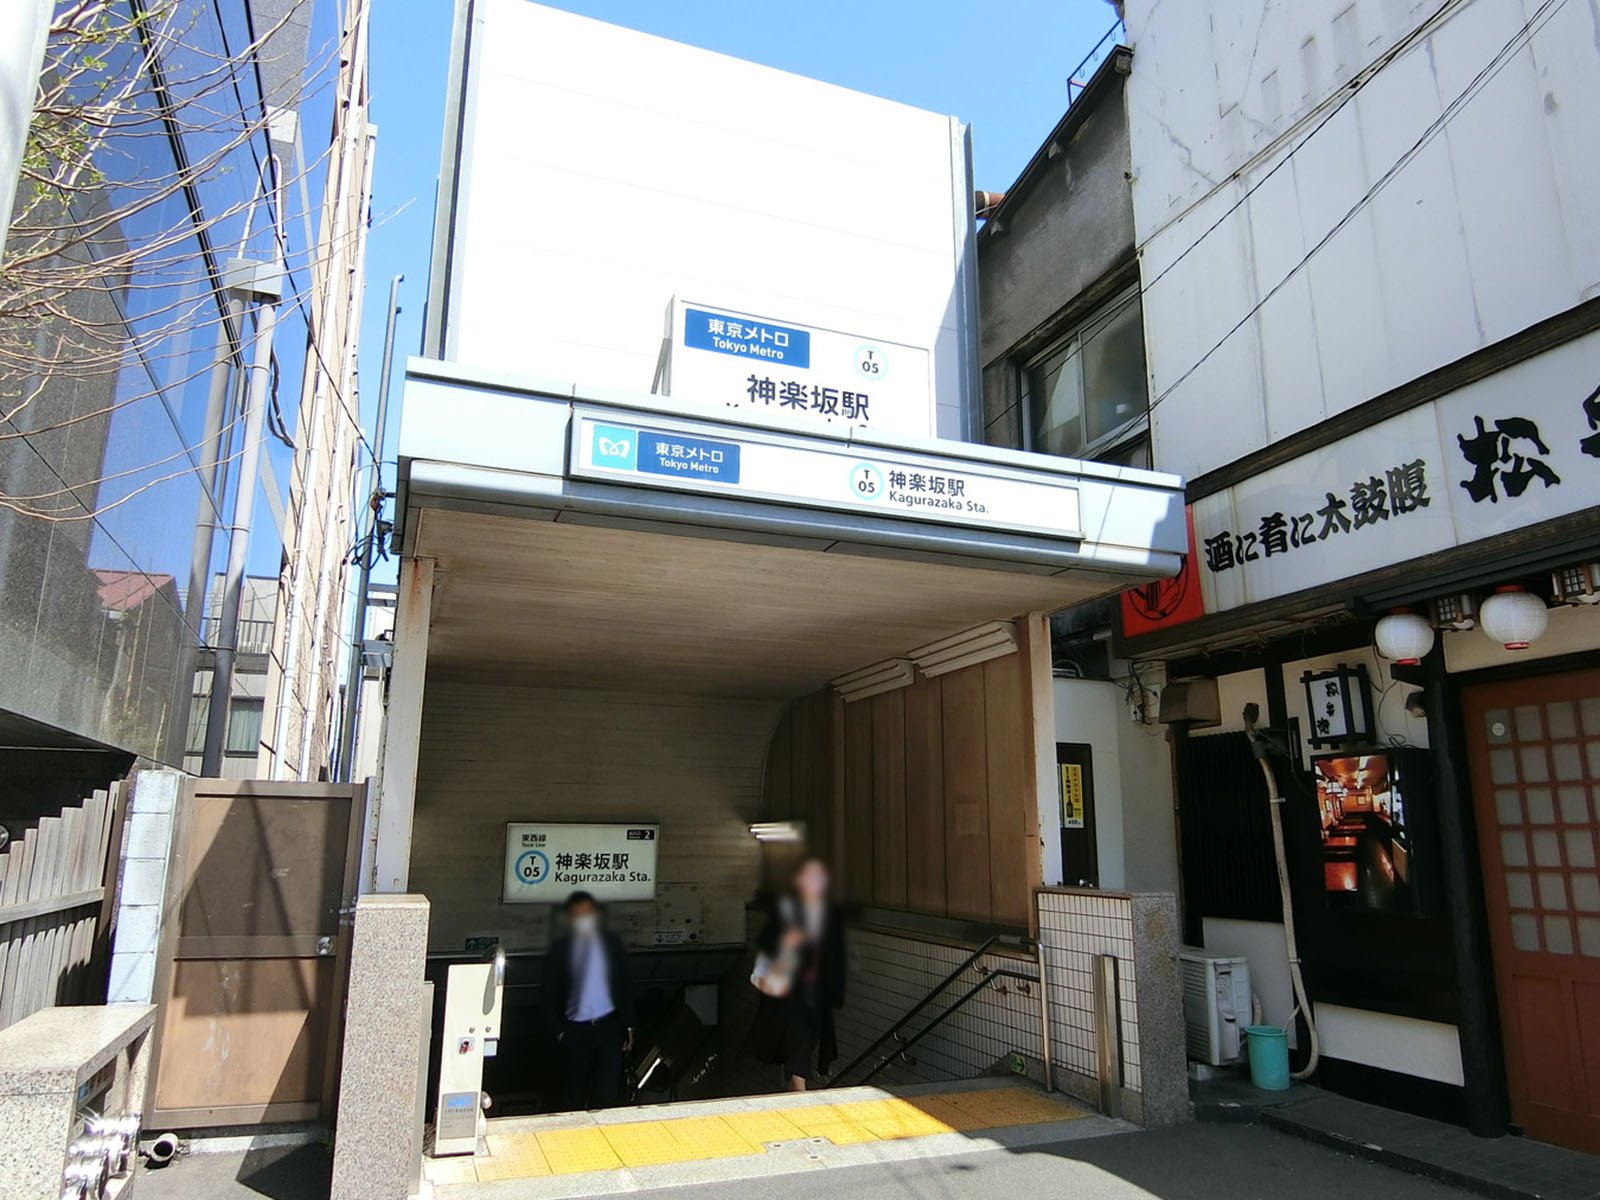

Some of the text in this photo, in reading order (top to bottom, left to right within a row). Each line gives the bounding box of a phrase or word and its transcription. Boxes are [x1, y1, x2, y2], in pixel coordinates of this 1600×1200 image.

[707, 317, 789, 347] 東京メトロ
[712, 336, 784, 360] Tokyo Metro
[867, 350, 874, 360] T
[862, 361, 879, 374] 05
[747, 373, 870, 421] 神楽坂駅
[655, 442, 724, 463] 東京メトロ
[659, 457, 719, 474] Tokyo Metro
[864, 469, 870, 480] T
[888, 469, 965, 497] 神楽坂駅
[858, 481, 875, 493] 05
[889, 490, 990, 514] Kagurazaka Sta.
[1204, 458, 1431, 572] 酒に肴に太鼓腹
[644, 830, 651, 840] 2
[529, 856, 537, 866] T
[555, 852, 629, 870] 神楽坂駅
[523, 866, 540, 878] 05
[554, 871, 651, 885] Kagurazaka Sta.
